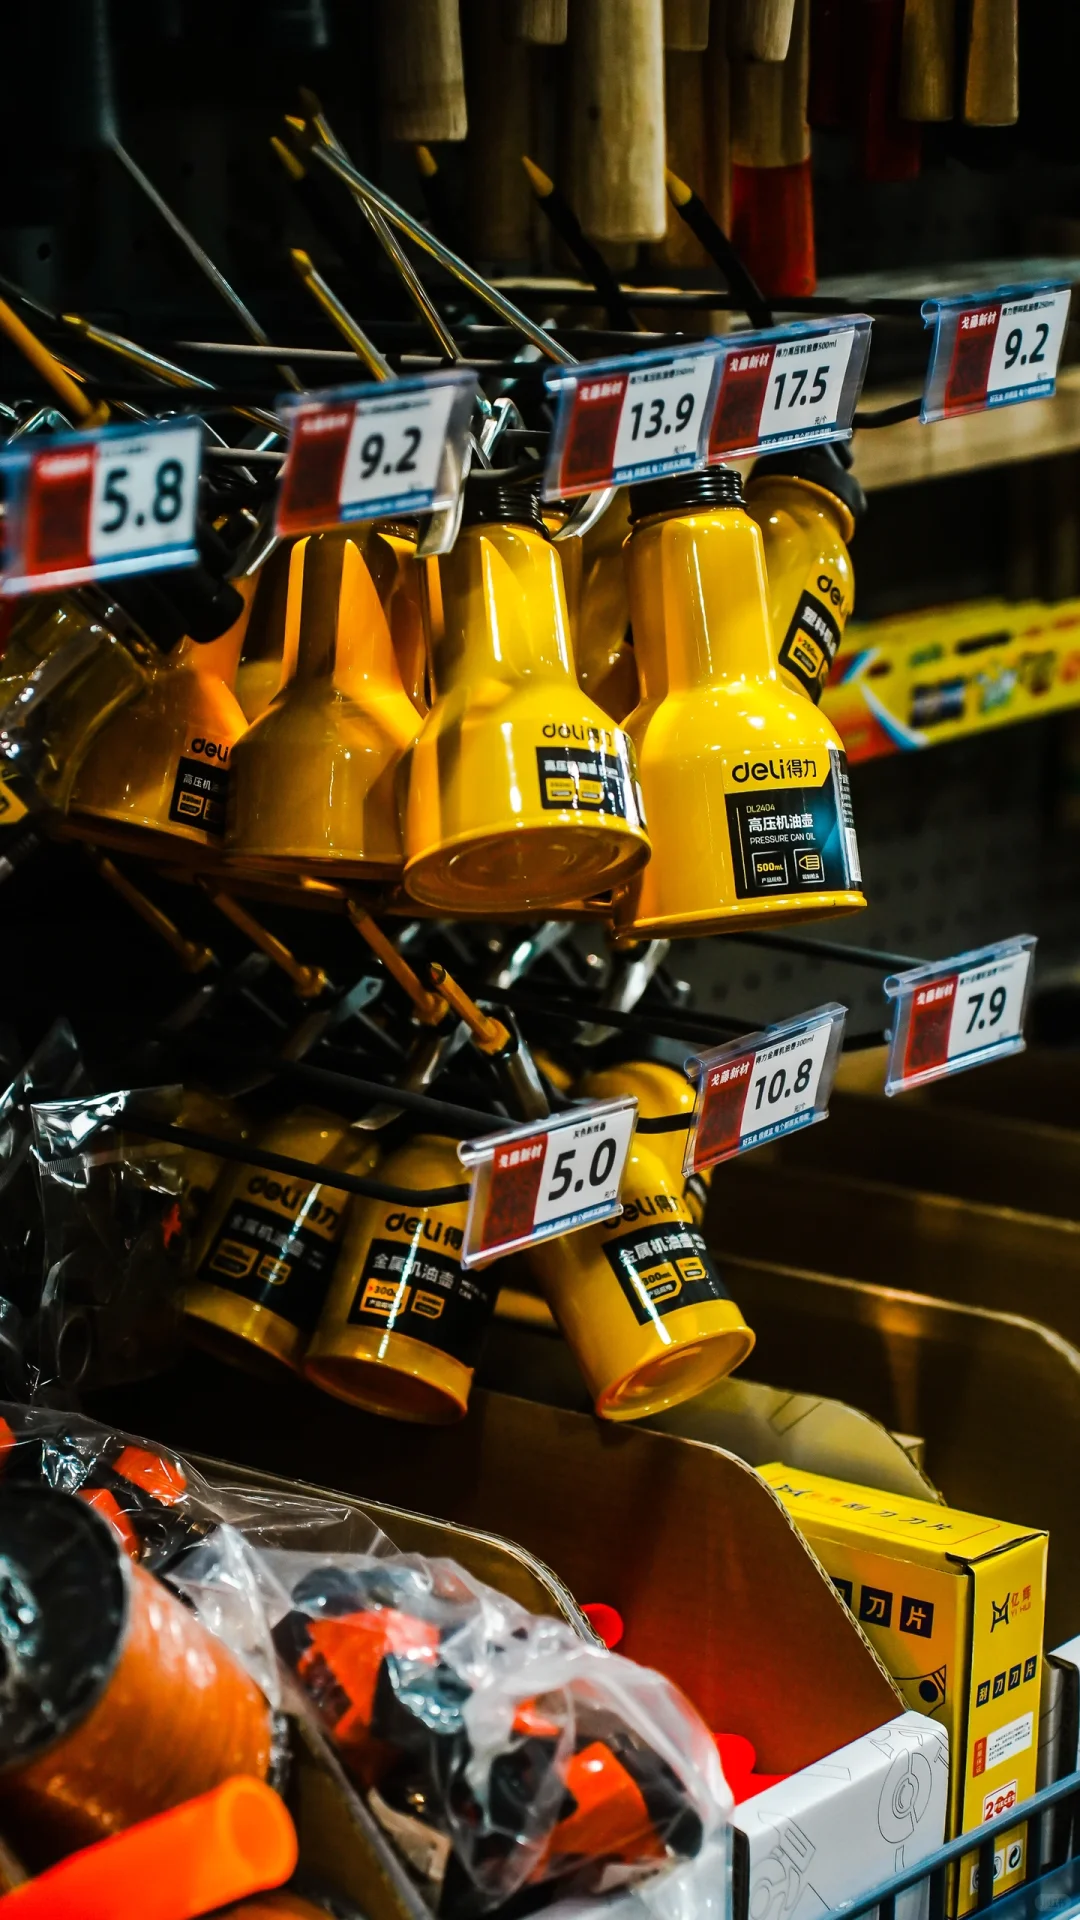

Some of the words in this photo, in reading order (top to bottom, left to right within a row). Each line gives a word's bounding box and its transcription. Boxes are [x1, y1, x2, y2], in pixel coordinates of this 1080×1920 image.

[1004, 323, 1049, 369] 9.2
[774, 366, 830, 411] 17.5
[631, 393, 695, 441] 13.9
[360, 426, 421, 479] 9.2
[102, 459, 183, 533] 5.8
[191, 738, 229, 763] deli
[746, 803, 776, 814] DL2404
[748, 813, 814, 833] 高压机油壶
[749, 834, 789, 845] PRESSURE
[790, 833, 805, 842] CAN
[805, 832, 816, 841] OIL
[966, 986, 1007, 1034] 7.9
[755, 1058, 813, 1110] 10.8
[548, 1138, 617, 1201] 5.0
